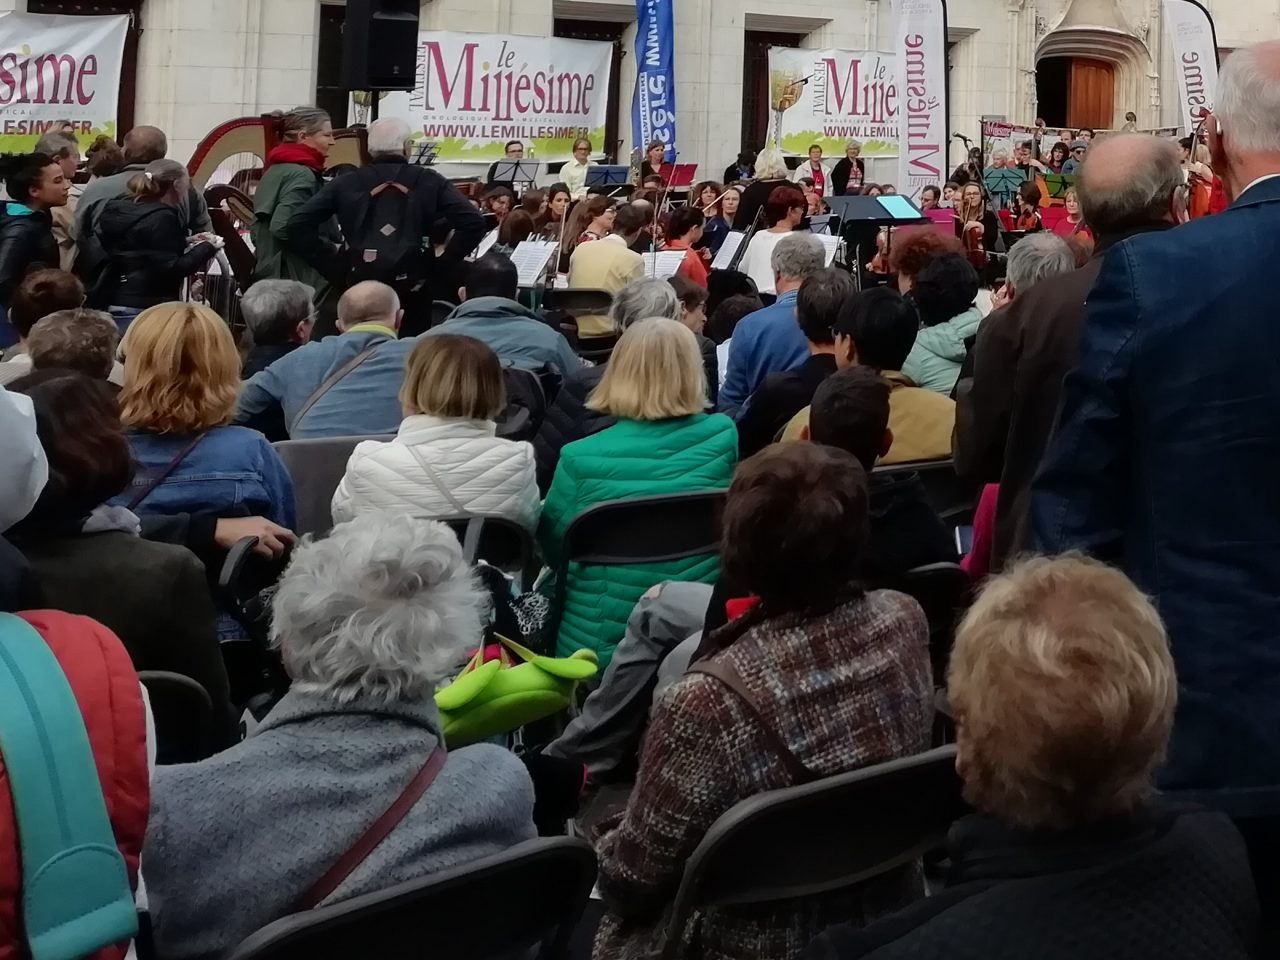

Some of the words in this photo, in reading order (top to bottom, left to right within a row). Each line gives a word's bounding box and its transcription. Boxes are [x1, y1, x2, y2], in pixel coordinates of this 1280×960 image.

[497, 40, 516, 68] le
[873, 57, 886, 80] le
[422, 41, 594, 122] Millésime
[812, 62, 826, 116] FESTIVAL
[822, 58, 900, 124] Millé
[423, 124, 589, 141] WWW.LEMILLESIME.FR
